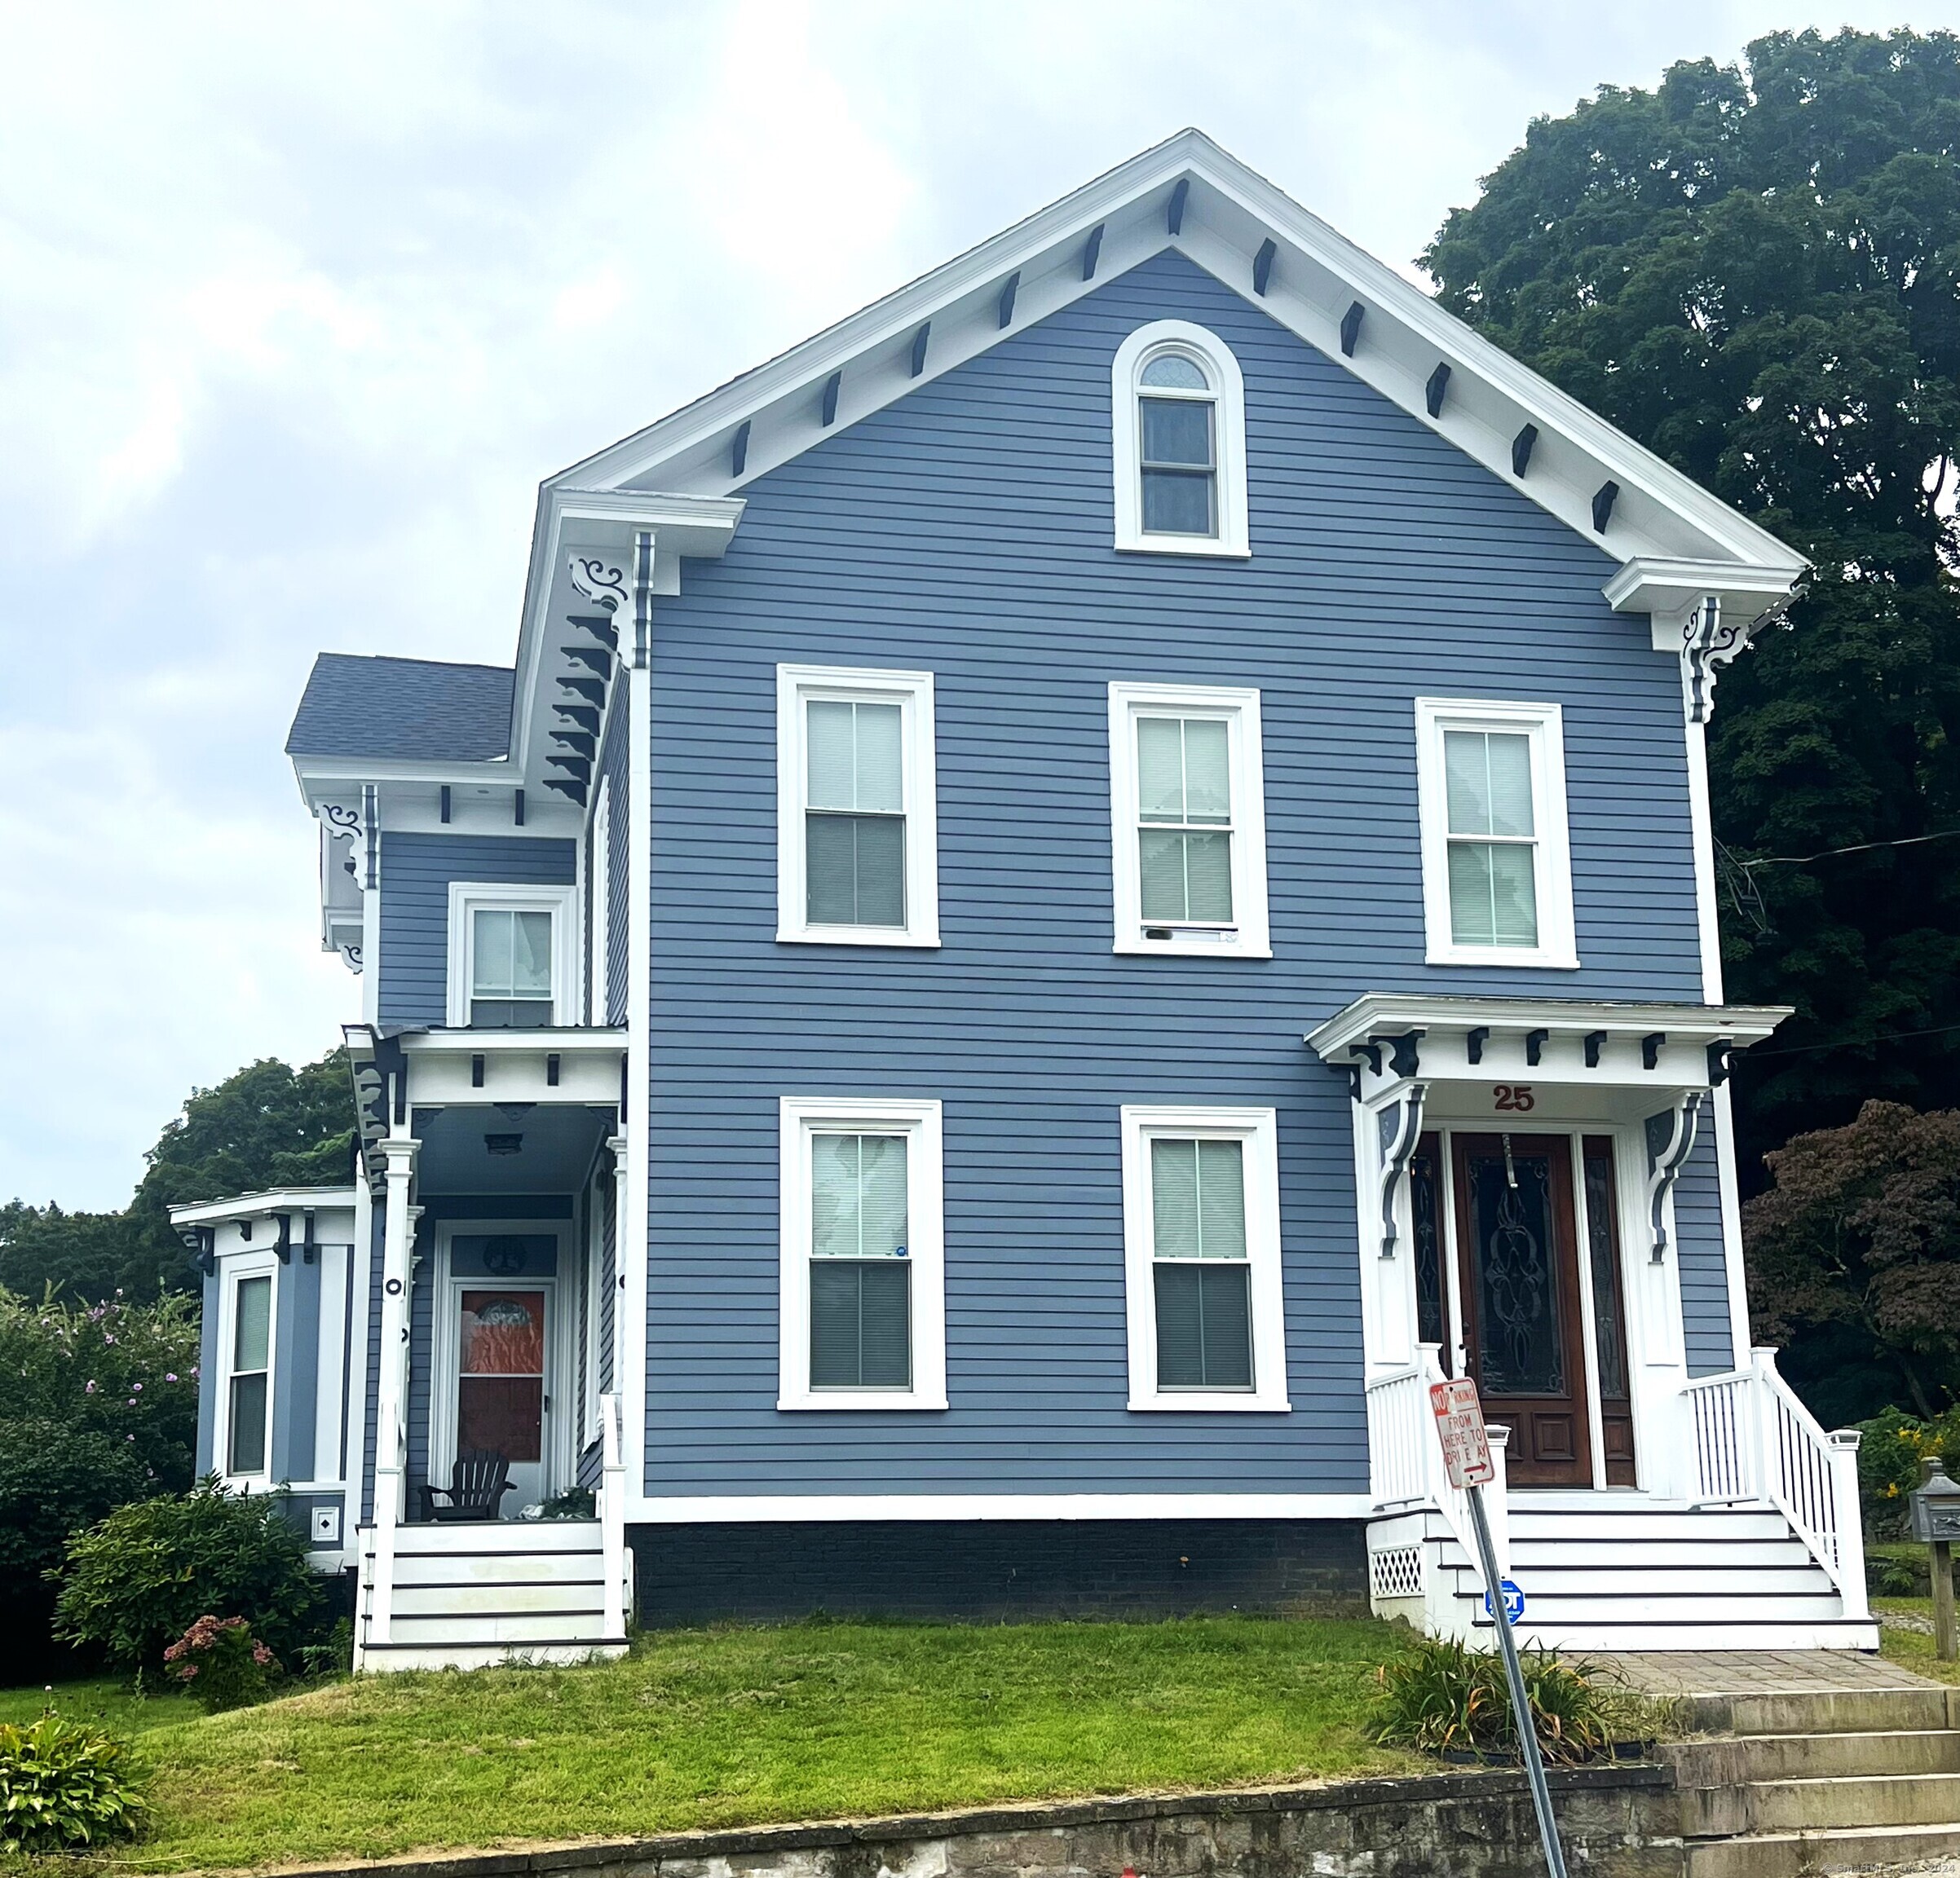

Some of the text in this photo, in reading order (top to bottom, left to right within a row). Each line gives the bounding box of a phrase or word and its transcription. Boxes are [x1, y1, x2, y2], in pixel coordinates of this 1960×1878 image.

[1493, 1085, 1534, 1111] 25
[1431, 1388, 1474, 1411] NO PRKING
[1448, 1414, 1472, 1430] FROM
[1444, 1429, 1482, 1448] HERE TO
[1446, 1445, 1485, 1466] DRIEAY
